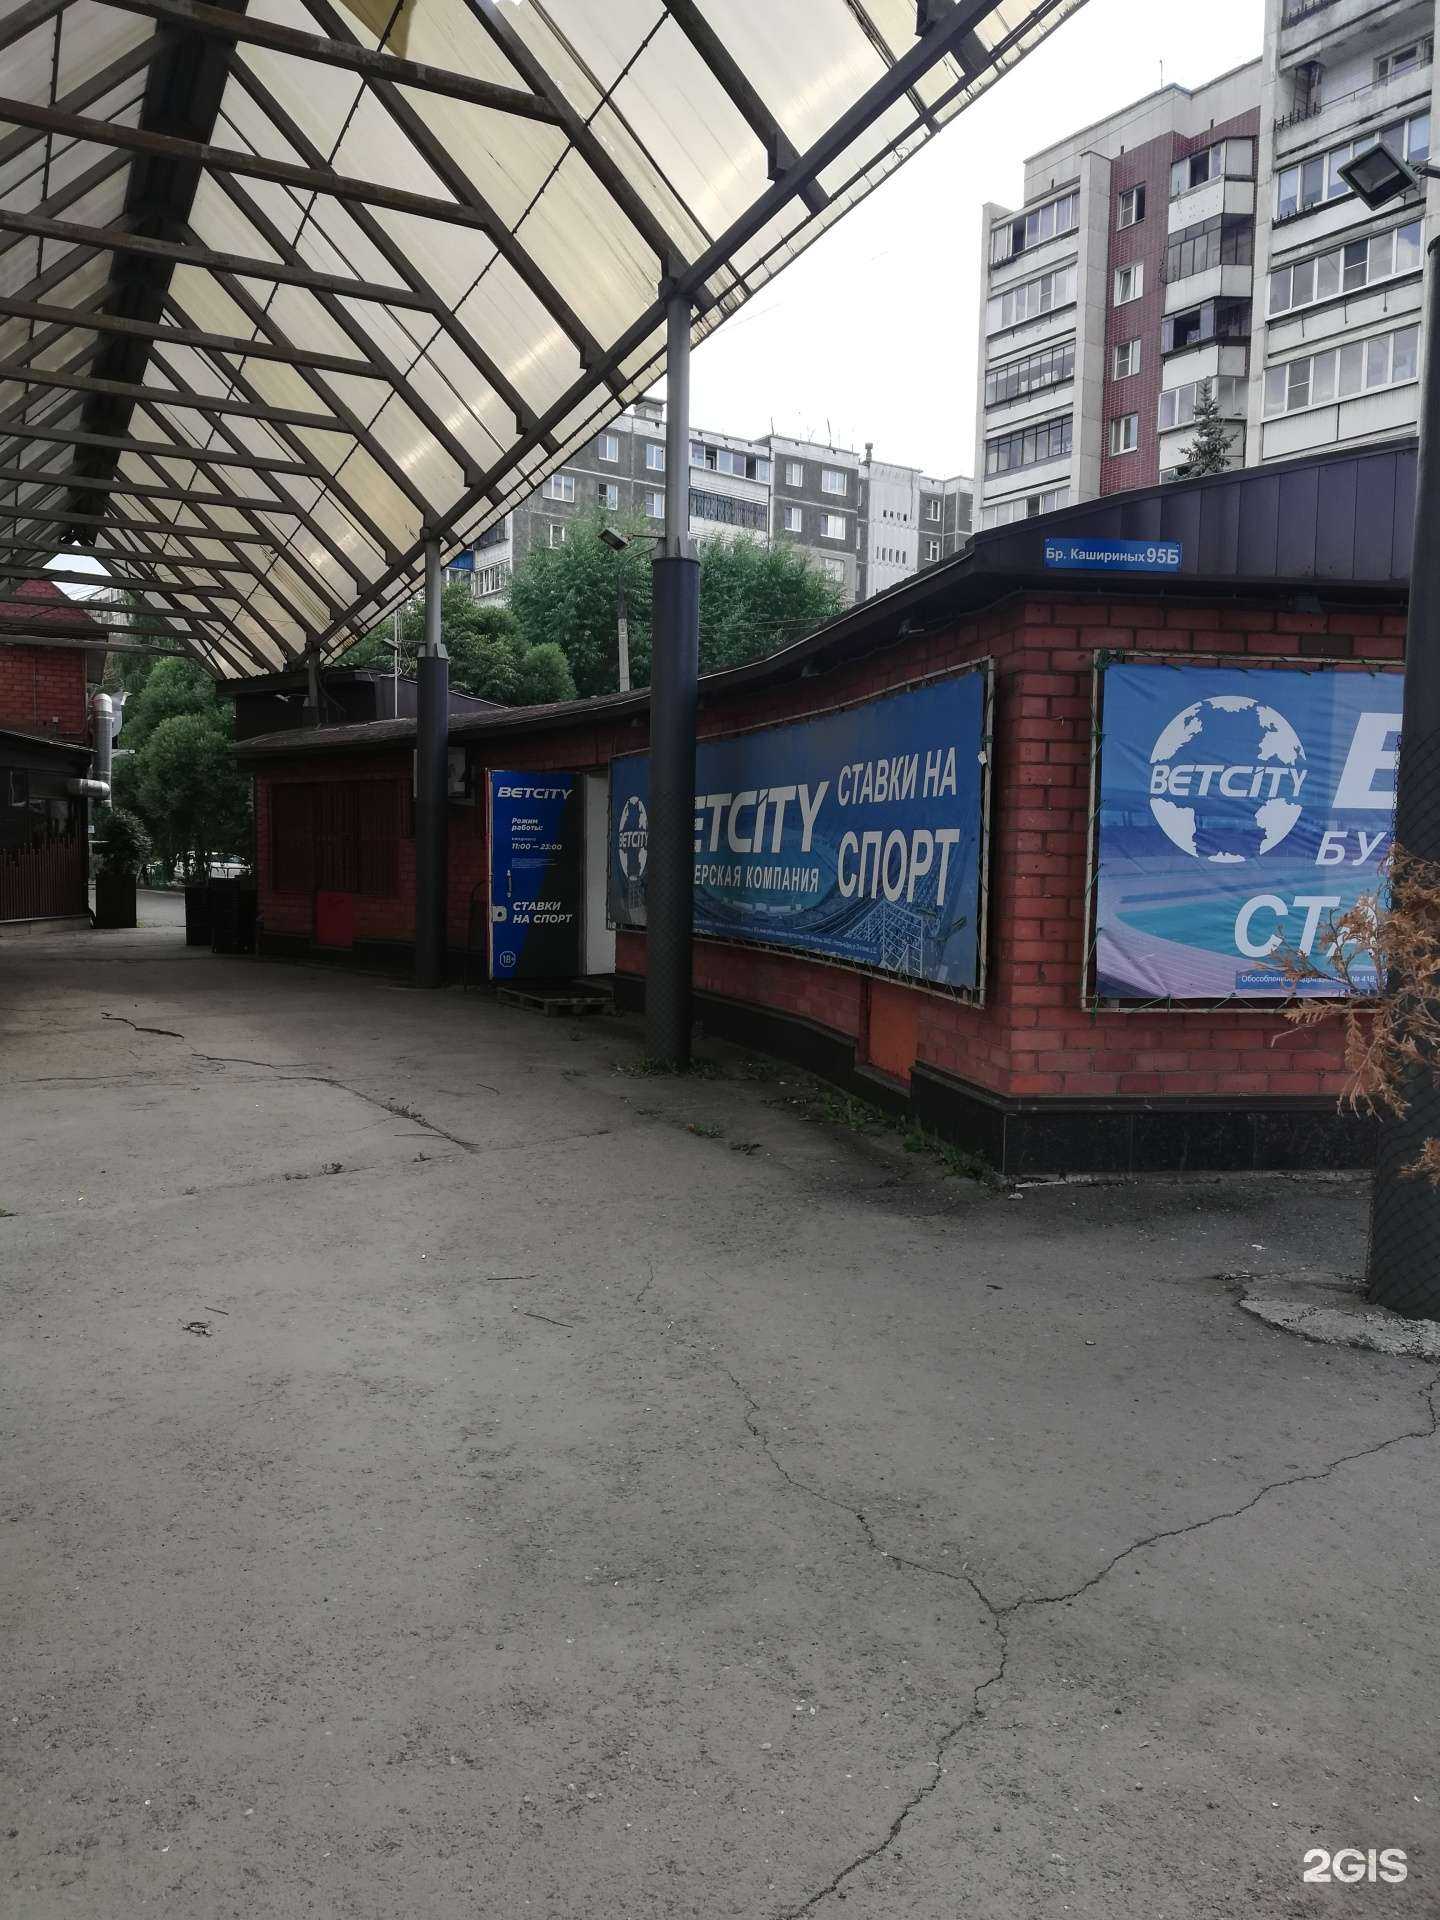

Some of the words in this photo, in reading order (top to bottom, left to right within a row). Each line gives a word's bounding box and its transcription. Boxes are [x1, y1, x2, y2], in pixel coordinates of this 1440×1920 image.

[1046, 547, 1066, 561] Бр.
[1070, 548, 1145, 563] Кашириных
[1146, 548, 1179, 564] 95Б
[836, 752, 919, 806] СТАВКИ
[922, 746, 957, 798] НА
[1150, 764, 1307, 798] BETCITY
[497, 786, 575, 800] BETCITY
[511, 817, 539, 825] Режим
[694, 781, 830, 853] ETCITY
[618, 831, 649, 848] BETCITY
[1315, 831, 1396, 866] БУ
[836, 827, 961, 906] СПОРТ
[694, 864, 742, 888] ЕРСКАЯ
[745, 865, 819, 893] КОМПАНИЯ
[512, 901, 562, 911] СТАВКИ
[512, 914, 530, 924] НА
[533, 914, 573, 924] СПОРТ
[1234, 894, 1378, 958] СТА
[503, 954, 516, 964] 18+
